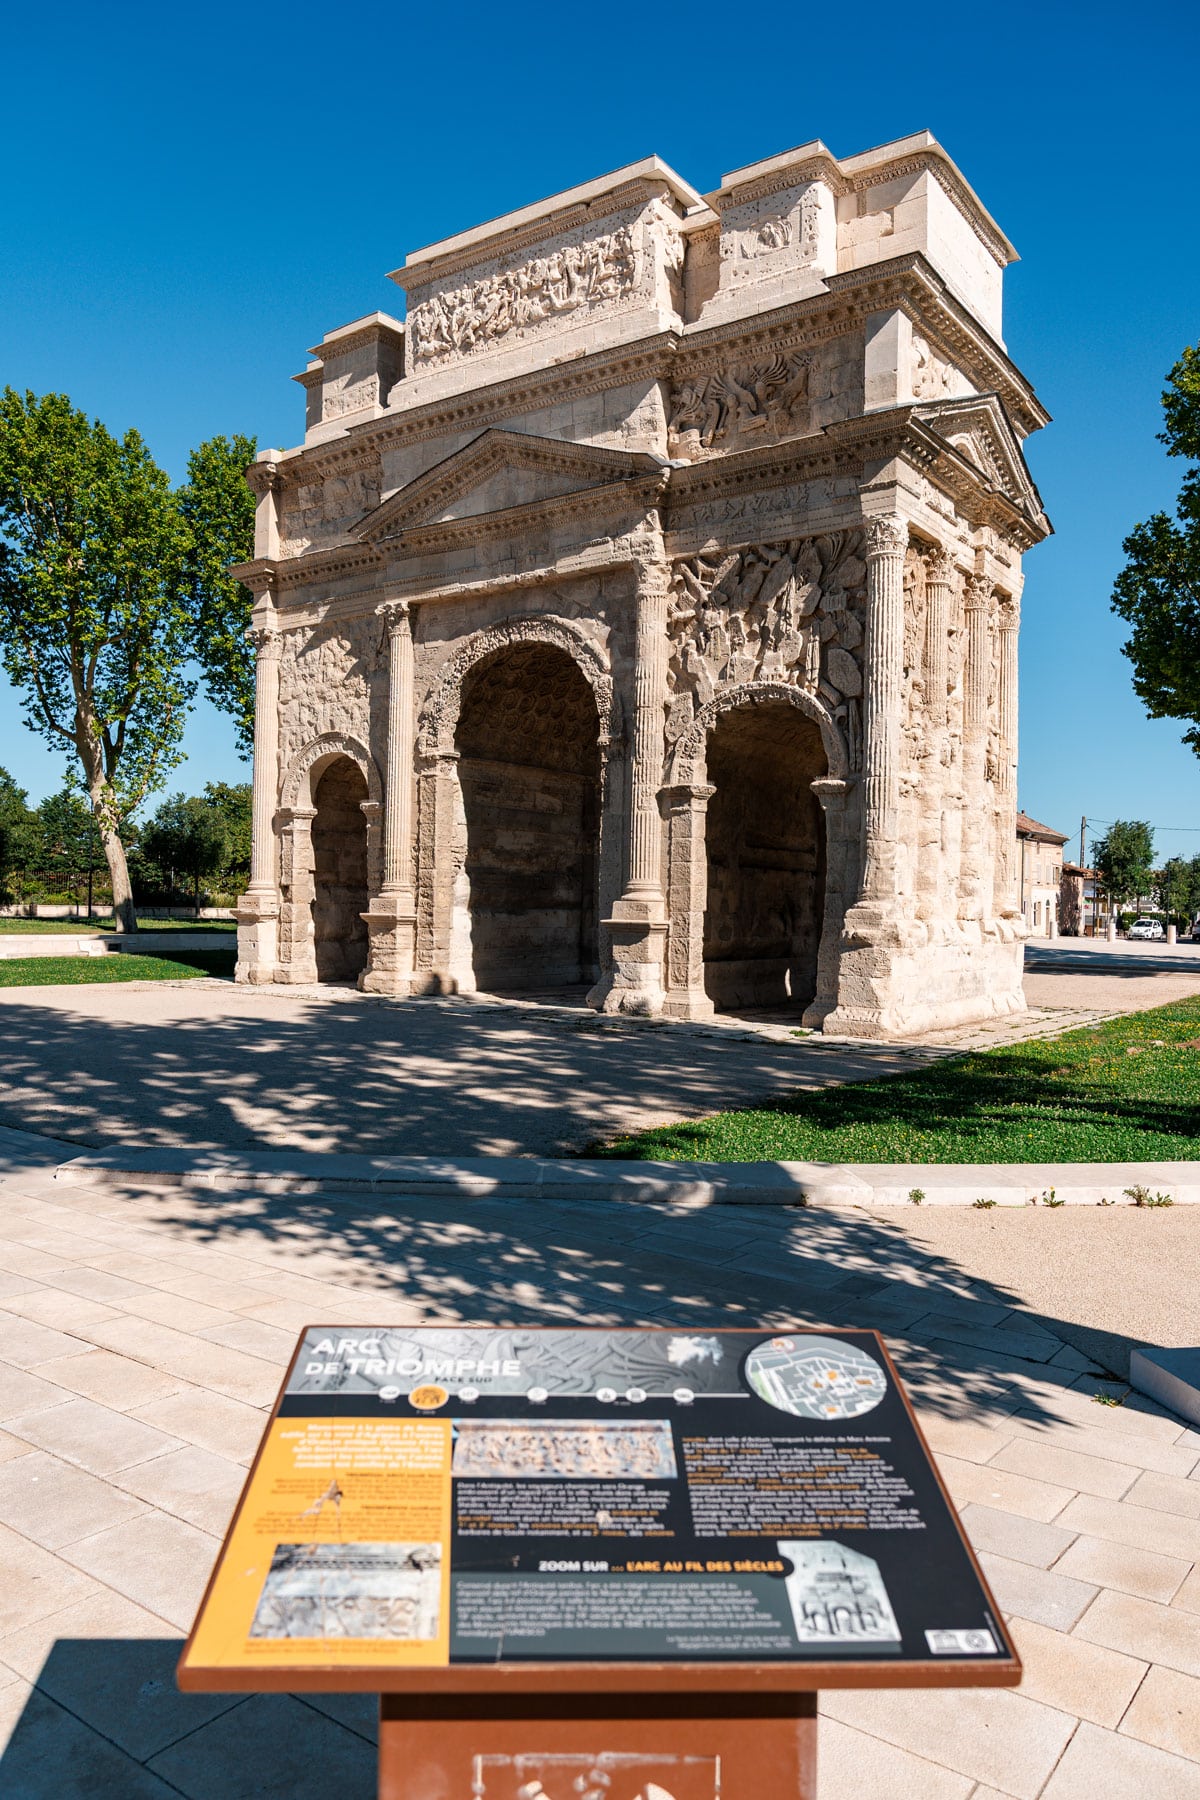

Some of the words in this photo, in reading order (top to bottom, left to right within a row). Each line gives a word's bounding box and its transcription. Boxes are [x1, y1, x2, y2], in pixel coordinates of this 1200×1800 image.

[311, 1338, 381, 1354] ARC
[305, 1361, 340, 1375] DE
[346, 1358, 521, 1377] TRIOMPHE
[539, 1560, 580, 1572] ZOOM
[582, 1560, 609, 1572] SUR
[663, 1561, 683, 1572] AU
[685, 1561, 705, 1572] FIL
[706, 1561, 732, 1572] DES
